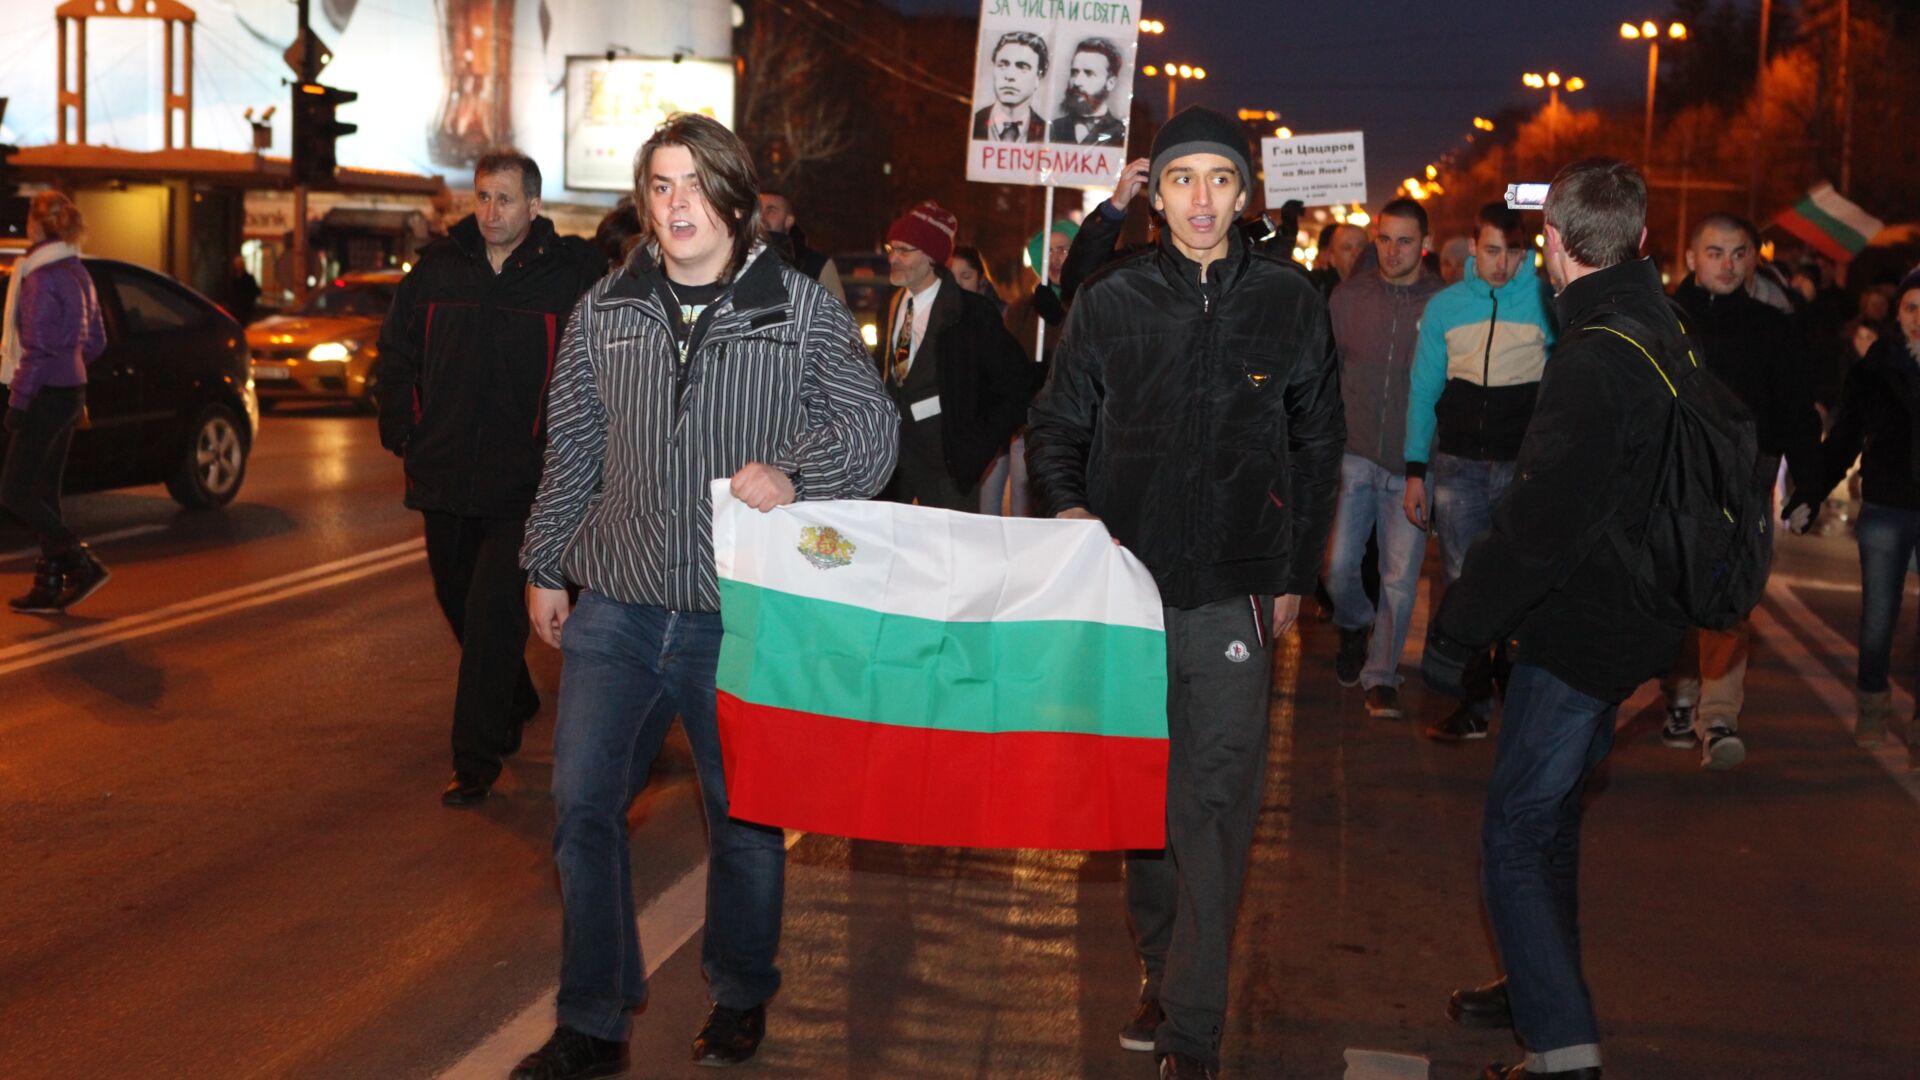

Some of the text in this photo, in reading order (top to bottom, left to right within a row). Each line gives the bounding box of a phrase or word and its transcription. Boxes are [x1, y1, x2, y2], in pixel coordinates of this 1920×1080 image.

[989, 0, 1011, 16] ЗА
[1083, 1, 1131, 25] СВЯТА
[982, 146, 1110, 176] РЕПУБЛИКА
[1272, 143, 1355, 156] Г-н Цацаров
